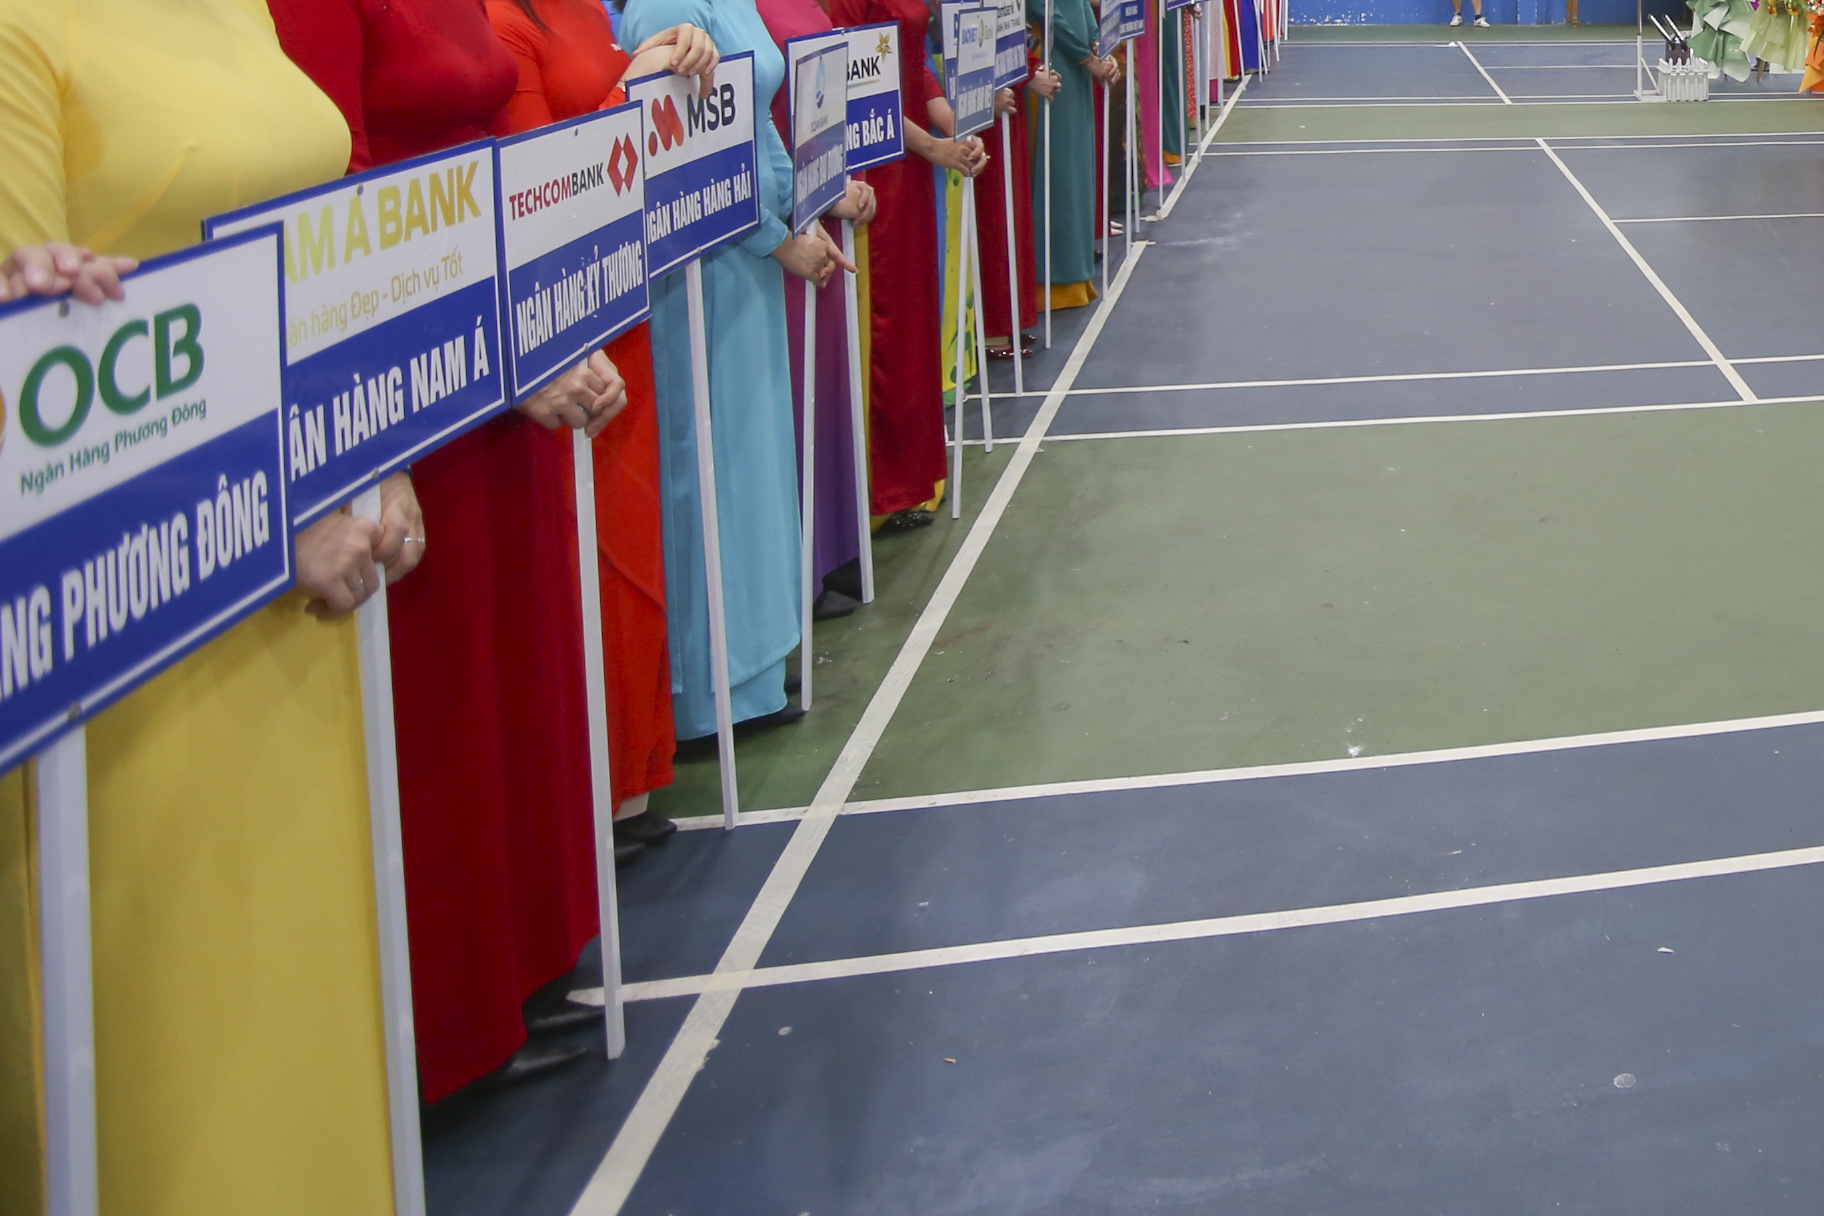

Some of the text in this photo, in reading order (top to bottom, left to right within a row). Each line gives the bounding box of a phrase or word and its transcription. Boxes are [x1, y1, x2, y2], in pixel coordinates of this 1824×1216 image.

[687, 83, 736, 138] MSB
[862, 108, 885, 148] BẮC
[886, 108, 895, 140] Á
[377, 160, 482, 252] BANK
[509, 162, 604, 221] TECHCOMBANK
[672, 191, 702, 231] HÀNG
[703, 178, 733, 217] HÀNG
[733, 162, 752, 204] HẢI
[310, 246, 464, 333] hàng Đẹp Dịch vụ Tốt
[516, 240, 644, 357] NGÂN HÀNG THƯƠNG
[18, 303, 205, 448] OCB
[332, 315, 490, 458] HÀNG NAM Á
[20, 398, 208, 495] Ngân Hàng Phương Đông
[62, 470, 270, 662] PHƯƠNG ĐÔNG
